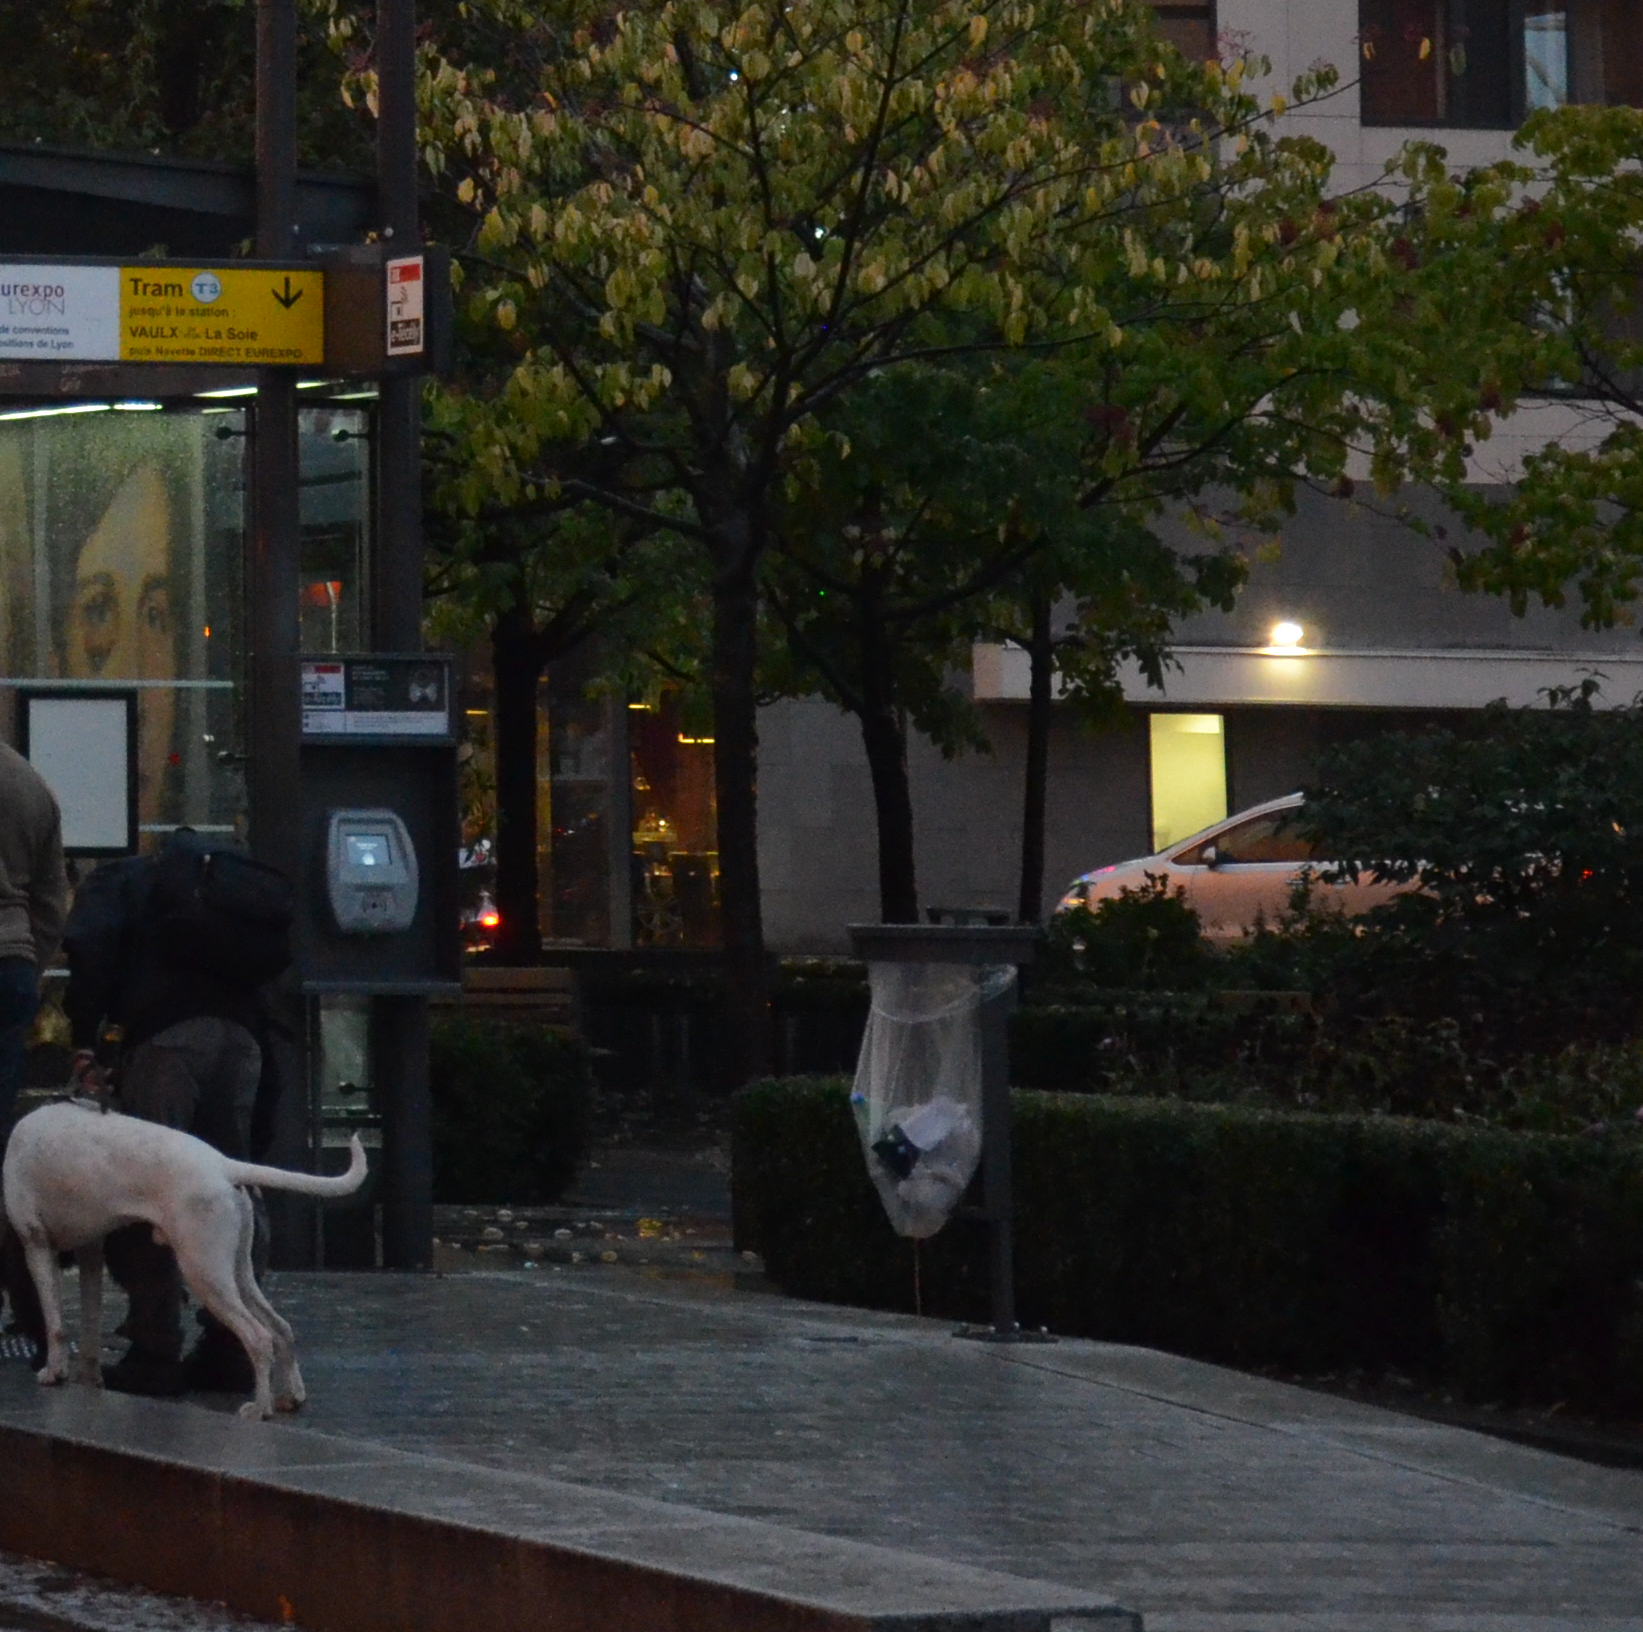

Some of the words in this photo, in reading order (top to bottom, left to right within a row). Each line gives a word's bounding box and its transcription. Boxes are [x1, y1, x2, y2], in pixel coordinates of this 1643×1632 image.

[129, 278, 183, 297] Tram
[194, 282, 219, 295] T3
[9, 298, 65, 316] LYON
[189, 306, 230, 318] station
[12, 325, 70, 336] conventions
[129, 326, 179, 339] VAULX
[205, 328, 222, 340] La
[226, 327, 259, 341] Soie
[36, 339, 49, 349] de
[50, 340, 75, 351] Lyon
[198, 347, 242, 357] DIRECT
[244, 348, 303, 359] EUREXPO
